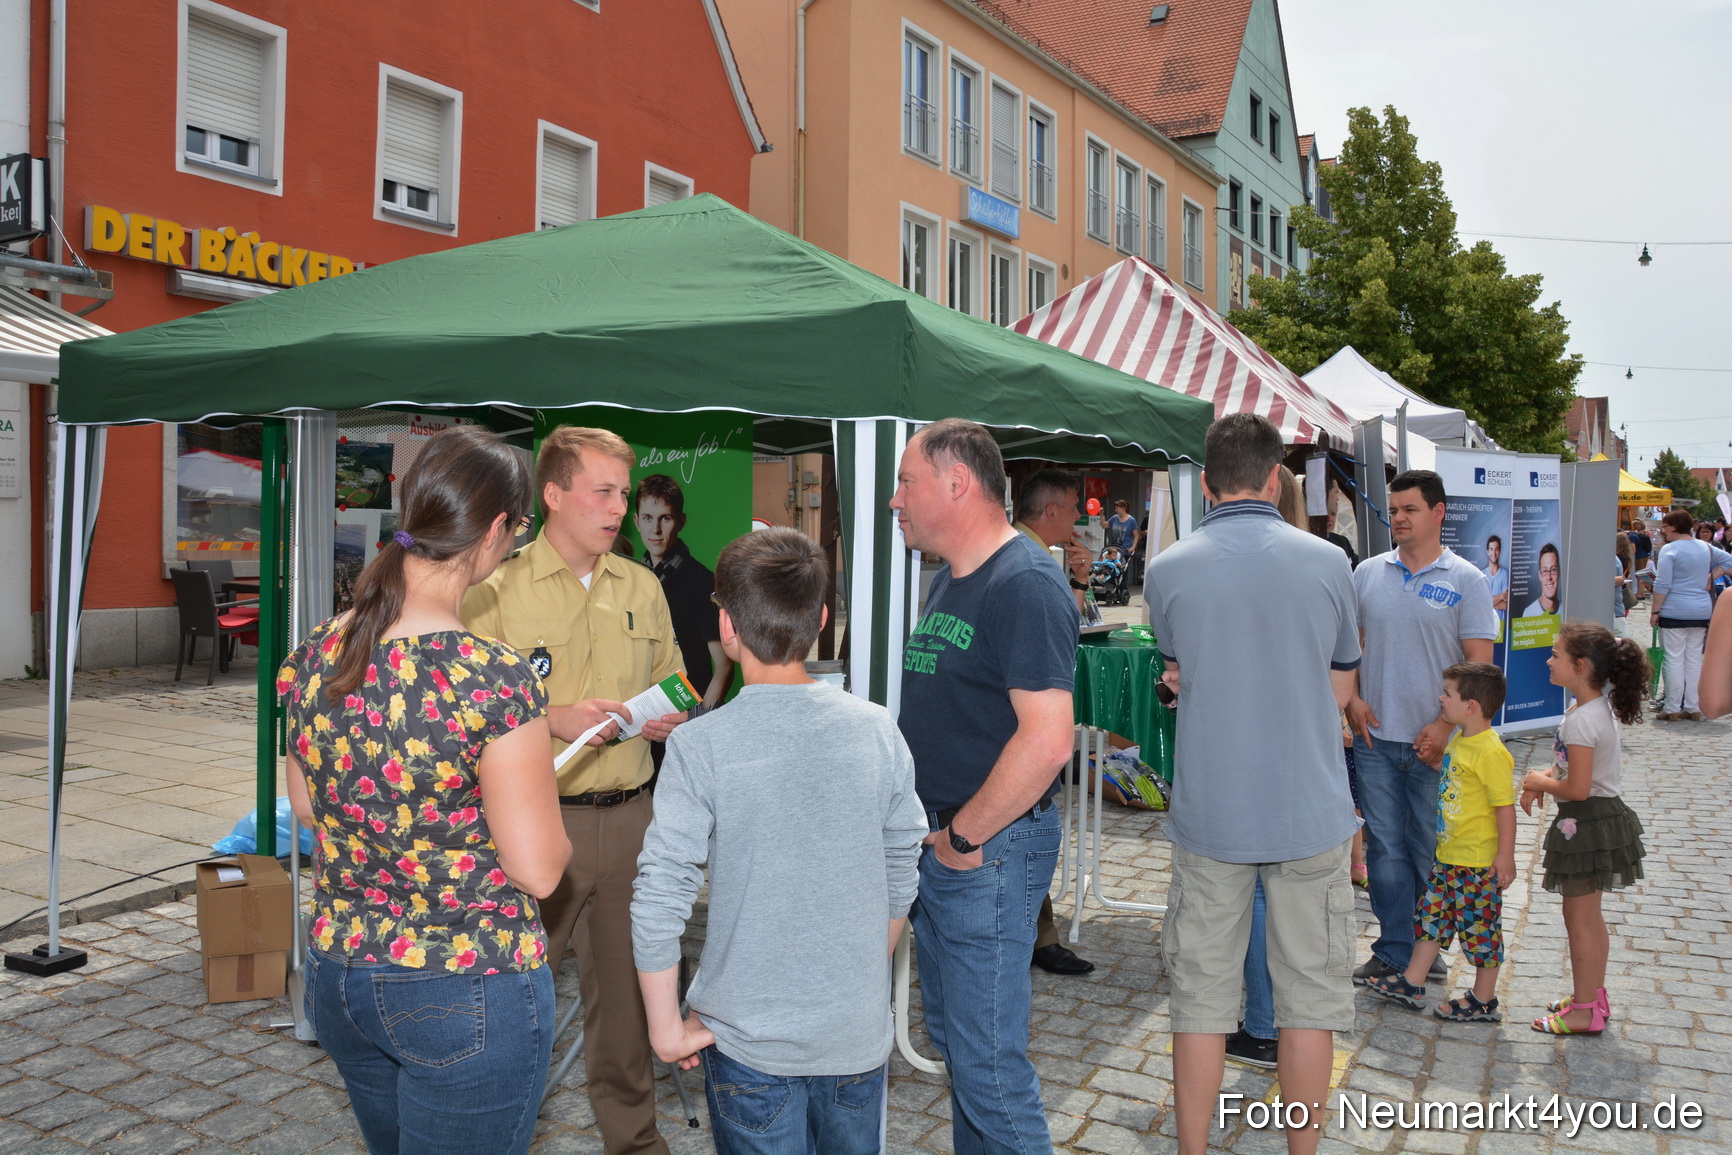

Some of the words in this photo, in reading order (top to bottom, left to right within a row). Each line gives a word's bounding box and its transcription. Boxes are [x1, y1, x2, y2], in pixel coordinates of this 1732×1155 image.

[91, 205, 186, 266] DER
[410, 421, 448, 437] Ausbild
[640, 447, 663, 468] als
[667, 446, 689, 462] ein
[1487, 470, 1512, 479] ECKERT
[1539, 473, 1558, 481] ECKERT
[1487, 479, 1512, 487] SCHULEN
[1446, 503, 1467, 511] TAATLICH
[1467, 503, 1494, 512] GEPRÜFTER
[1513, 506, 1523, 514] EDIZIN
[1445, 513, 1468, 521] ECHNIKER
[1418, 583, 1462, 607] RUF
[904, 649, 938, 675] SPORTS
[674, 682, 684, 694] Ich
[680, 691, 692, 702] will
